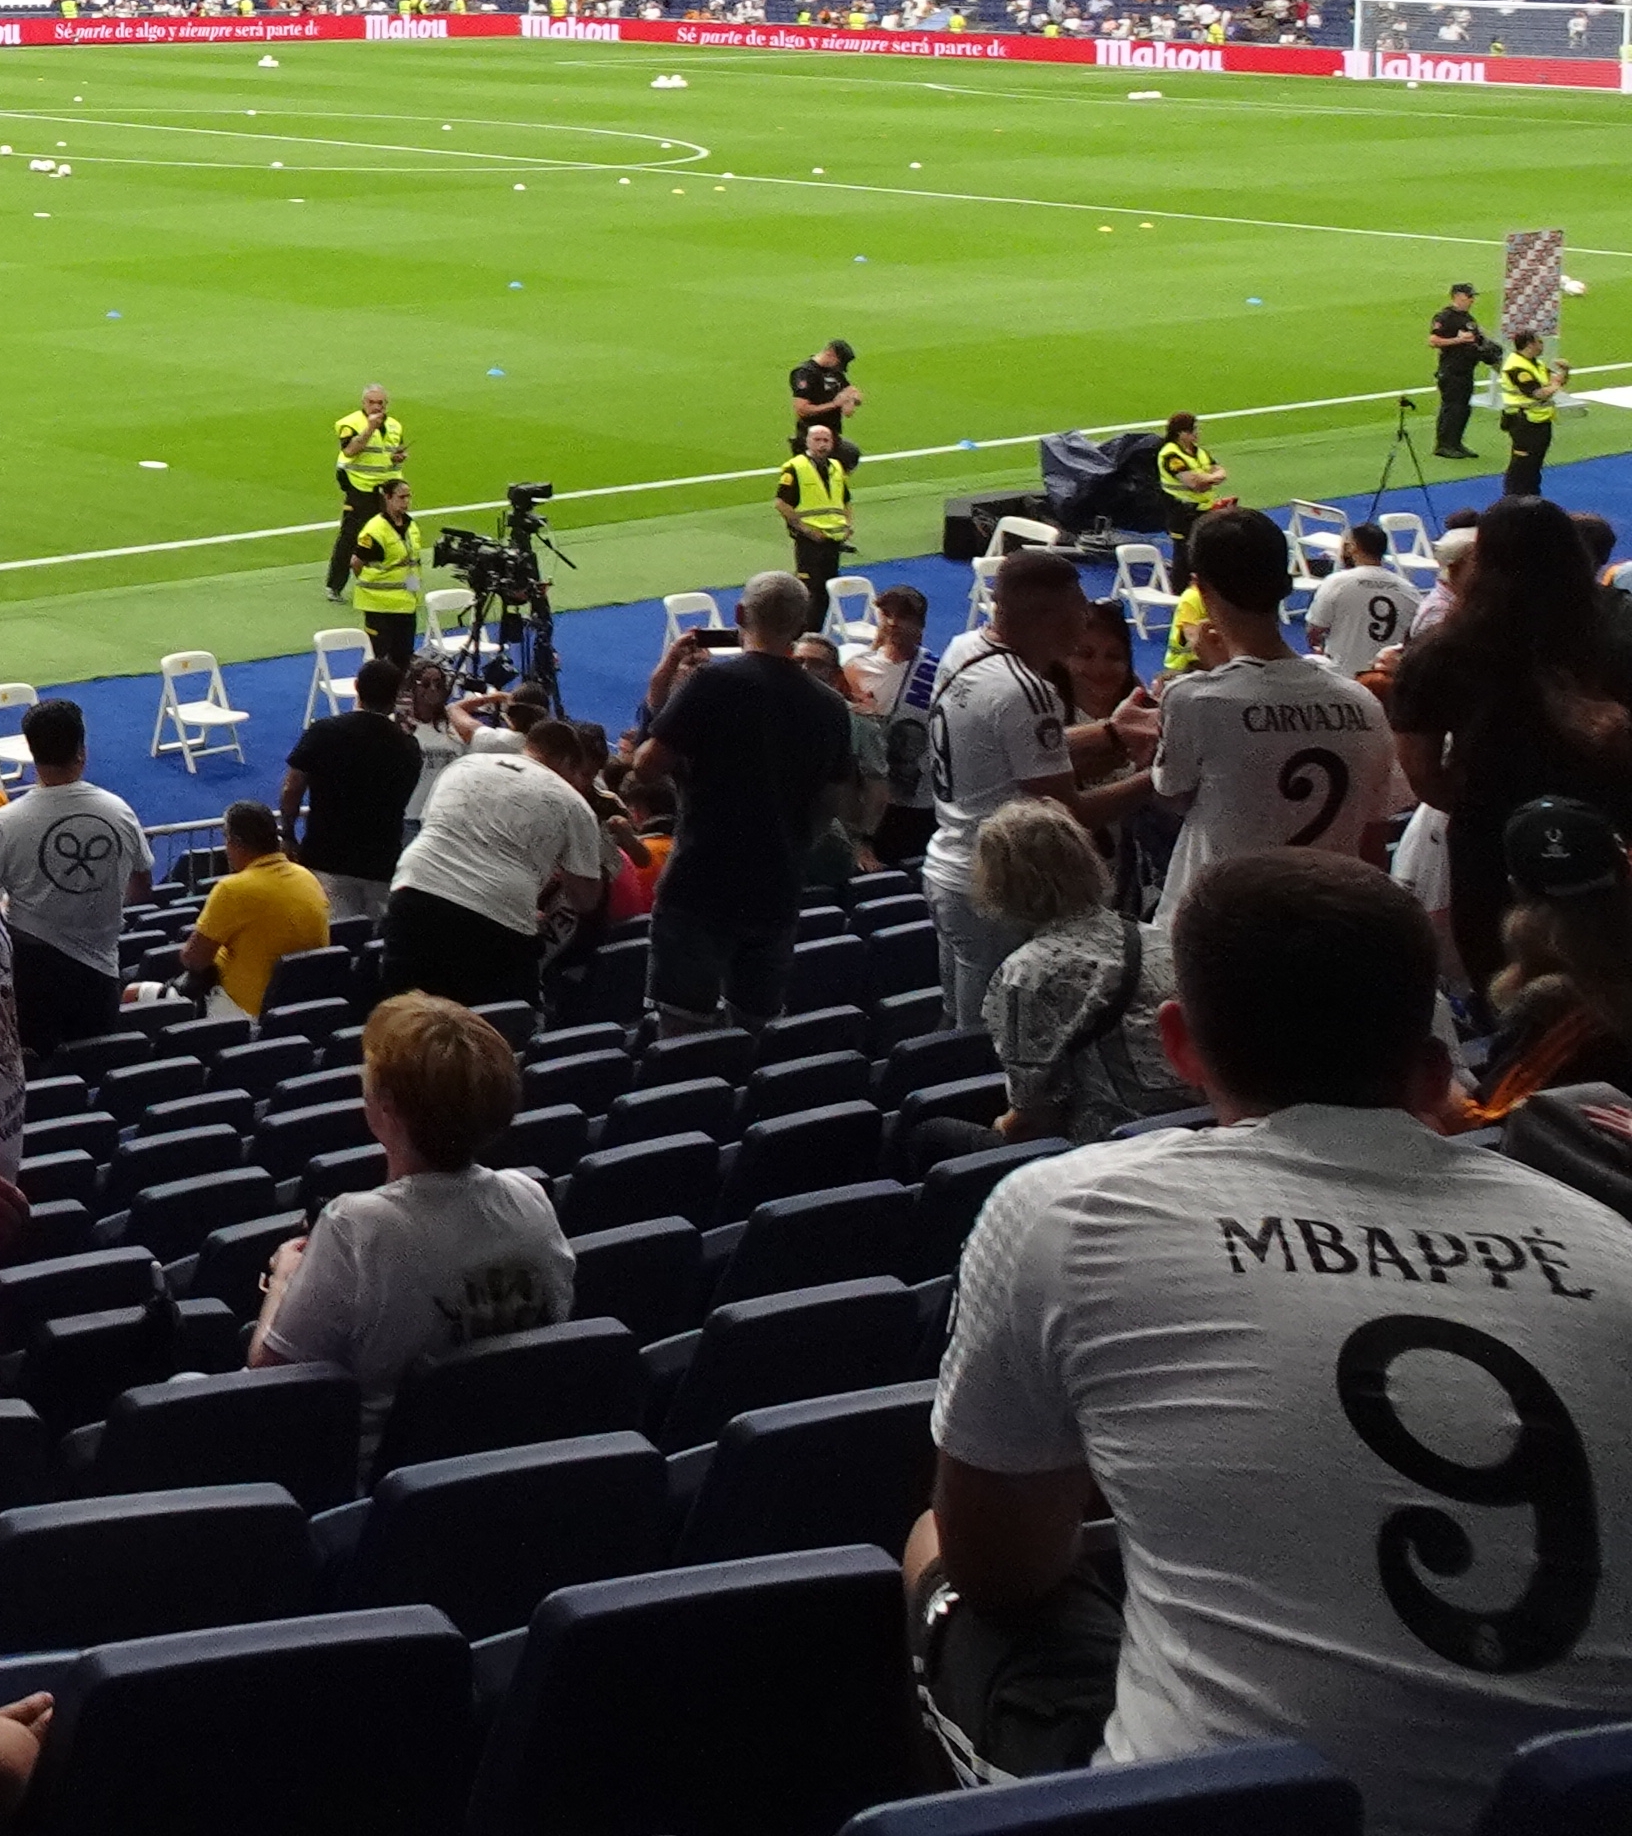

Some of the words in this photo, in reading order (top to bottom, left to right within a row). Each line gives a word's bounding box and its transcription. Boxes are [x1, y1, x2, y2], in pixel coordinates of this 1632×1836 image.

[54, 23, 73, 40] Sé
[74, 25, 113, 43] parte
[115, 23, 134, 39] de
[136, 22, 166, 41] algo
[167, 26, 178, 42] y
[179, 23, 232, 40] siempre
[235, 22, 264, 38] será
[266, 23, 303, 40] parte
[364, 14, 448, 40] Mahou
[520, 14, 621, 41] Mahou
[676, 26, 697, 43] Sé
[700, 27, 743, 46] parte
[746, 28, 766, 46] de
[769, 29, 806, 49] algo
[808, 33, 819, 50] y
[820, 32, 889, 53] siempre
[891, 36, 929, 54] será
[933, 40, 982, 58] parte
[1094, 38, 1225, 72] Mahou
[1368, 595, 1398, 642] 9
[1240, 702, 1374, 733] CARVAJAL
[1277, 746, 1349, 846] 2
[1215, 1218, 1597, 1302] MBAPPÉ
[1338, 1313, 1604, 1677] 9
